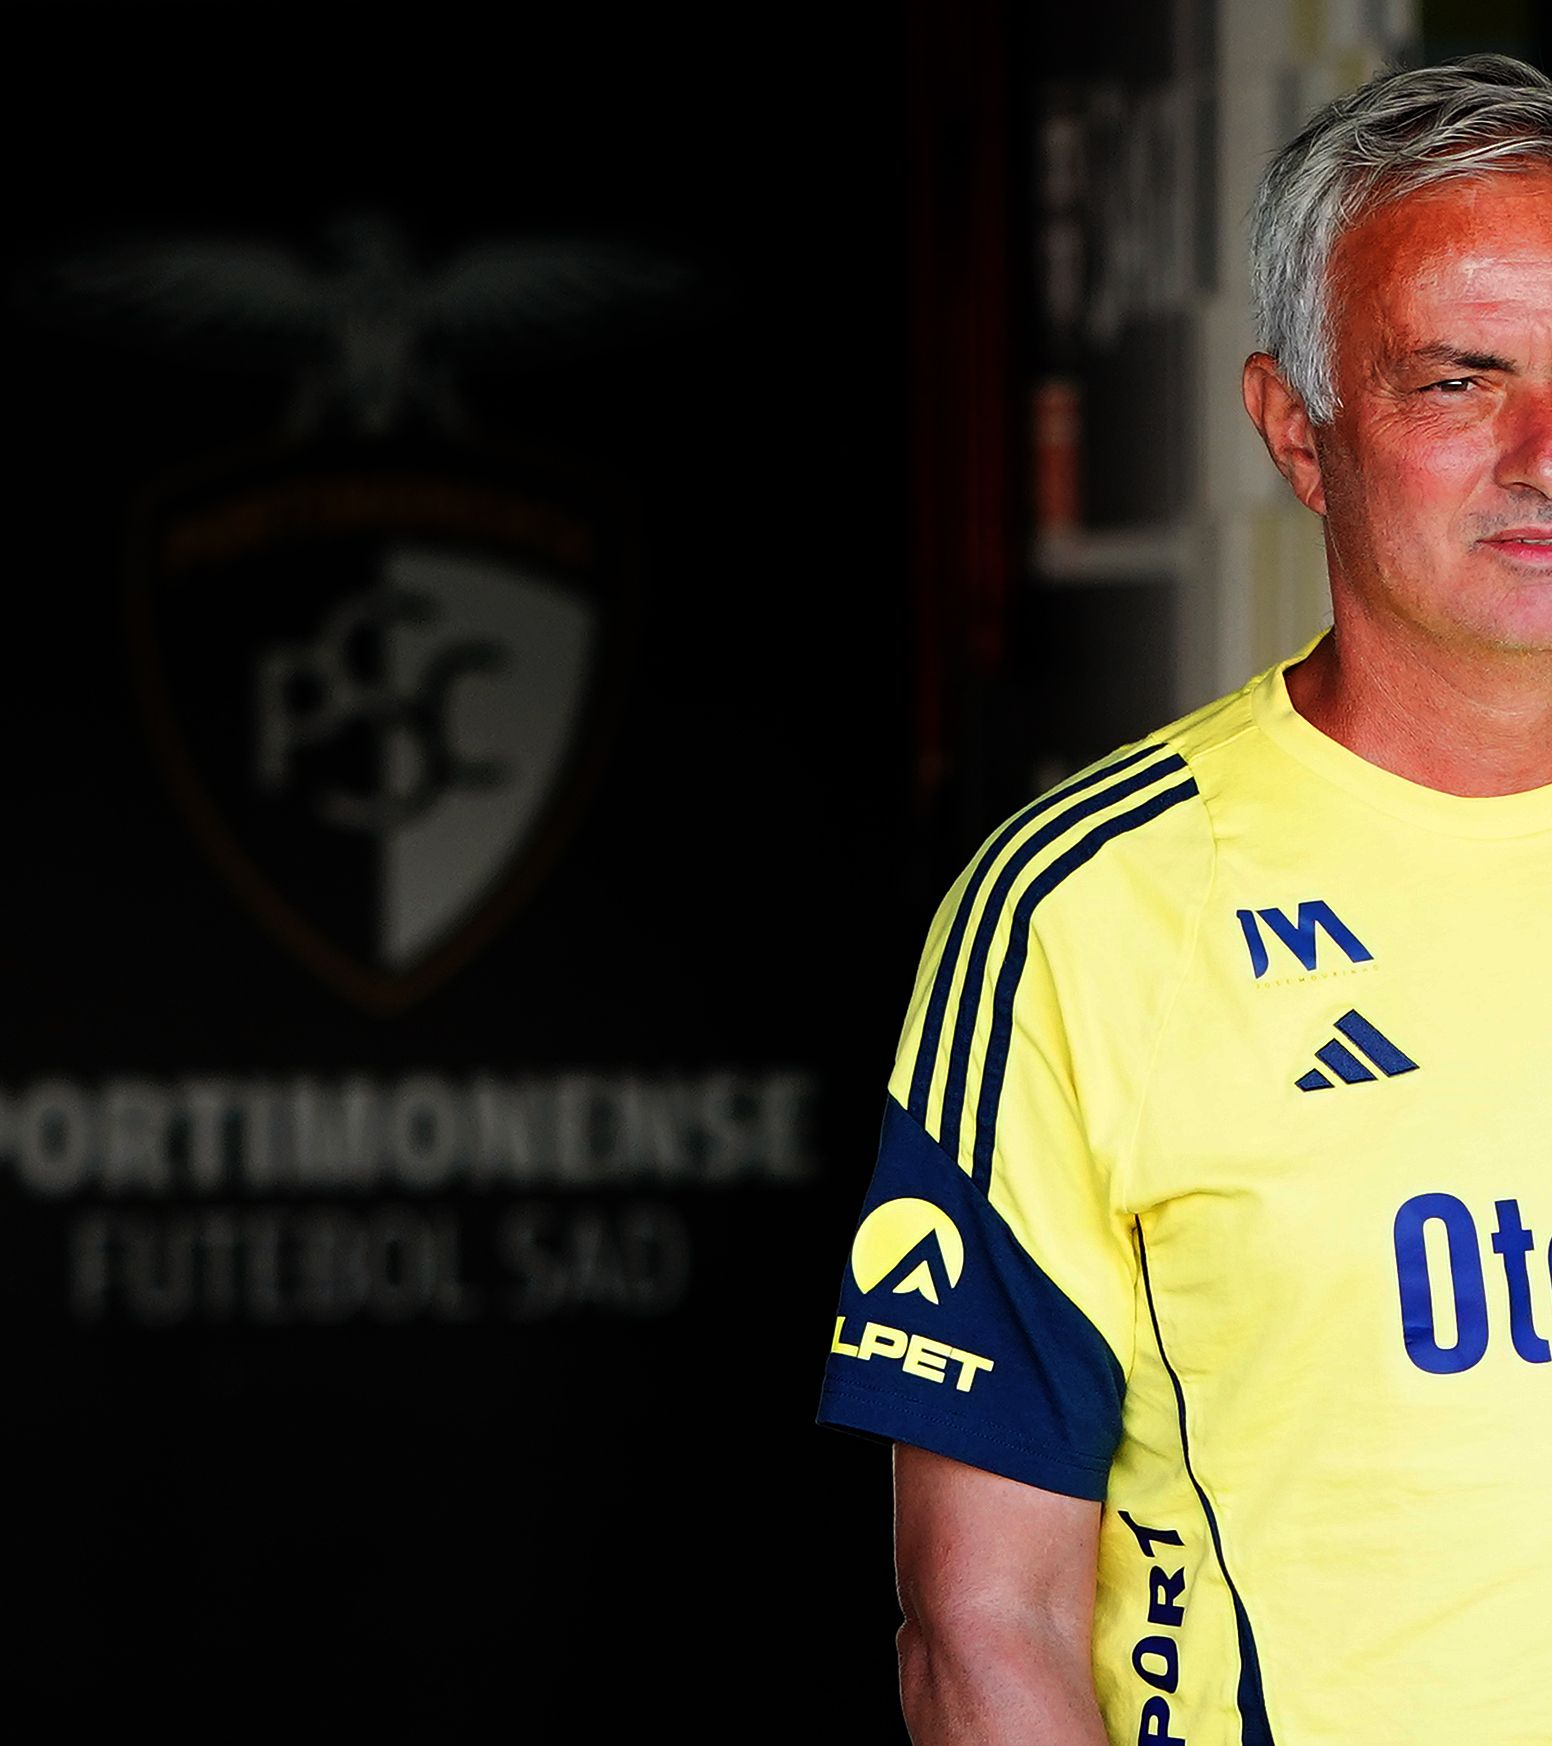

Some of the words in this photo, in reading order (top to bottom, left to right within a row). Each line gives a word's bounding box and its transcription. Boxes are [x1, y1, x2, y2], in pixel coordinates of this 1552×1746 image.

[1236, 899, 1375, 979] JM
[0, 1072, 816, 1190] ORTIMONENSE
[72, 1206, 476, 1325] FUTEBOL
[505, 1202, 690, 1318] SAD
